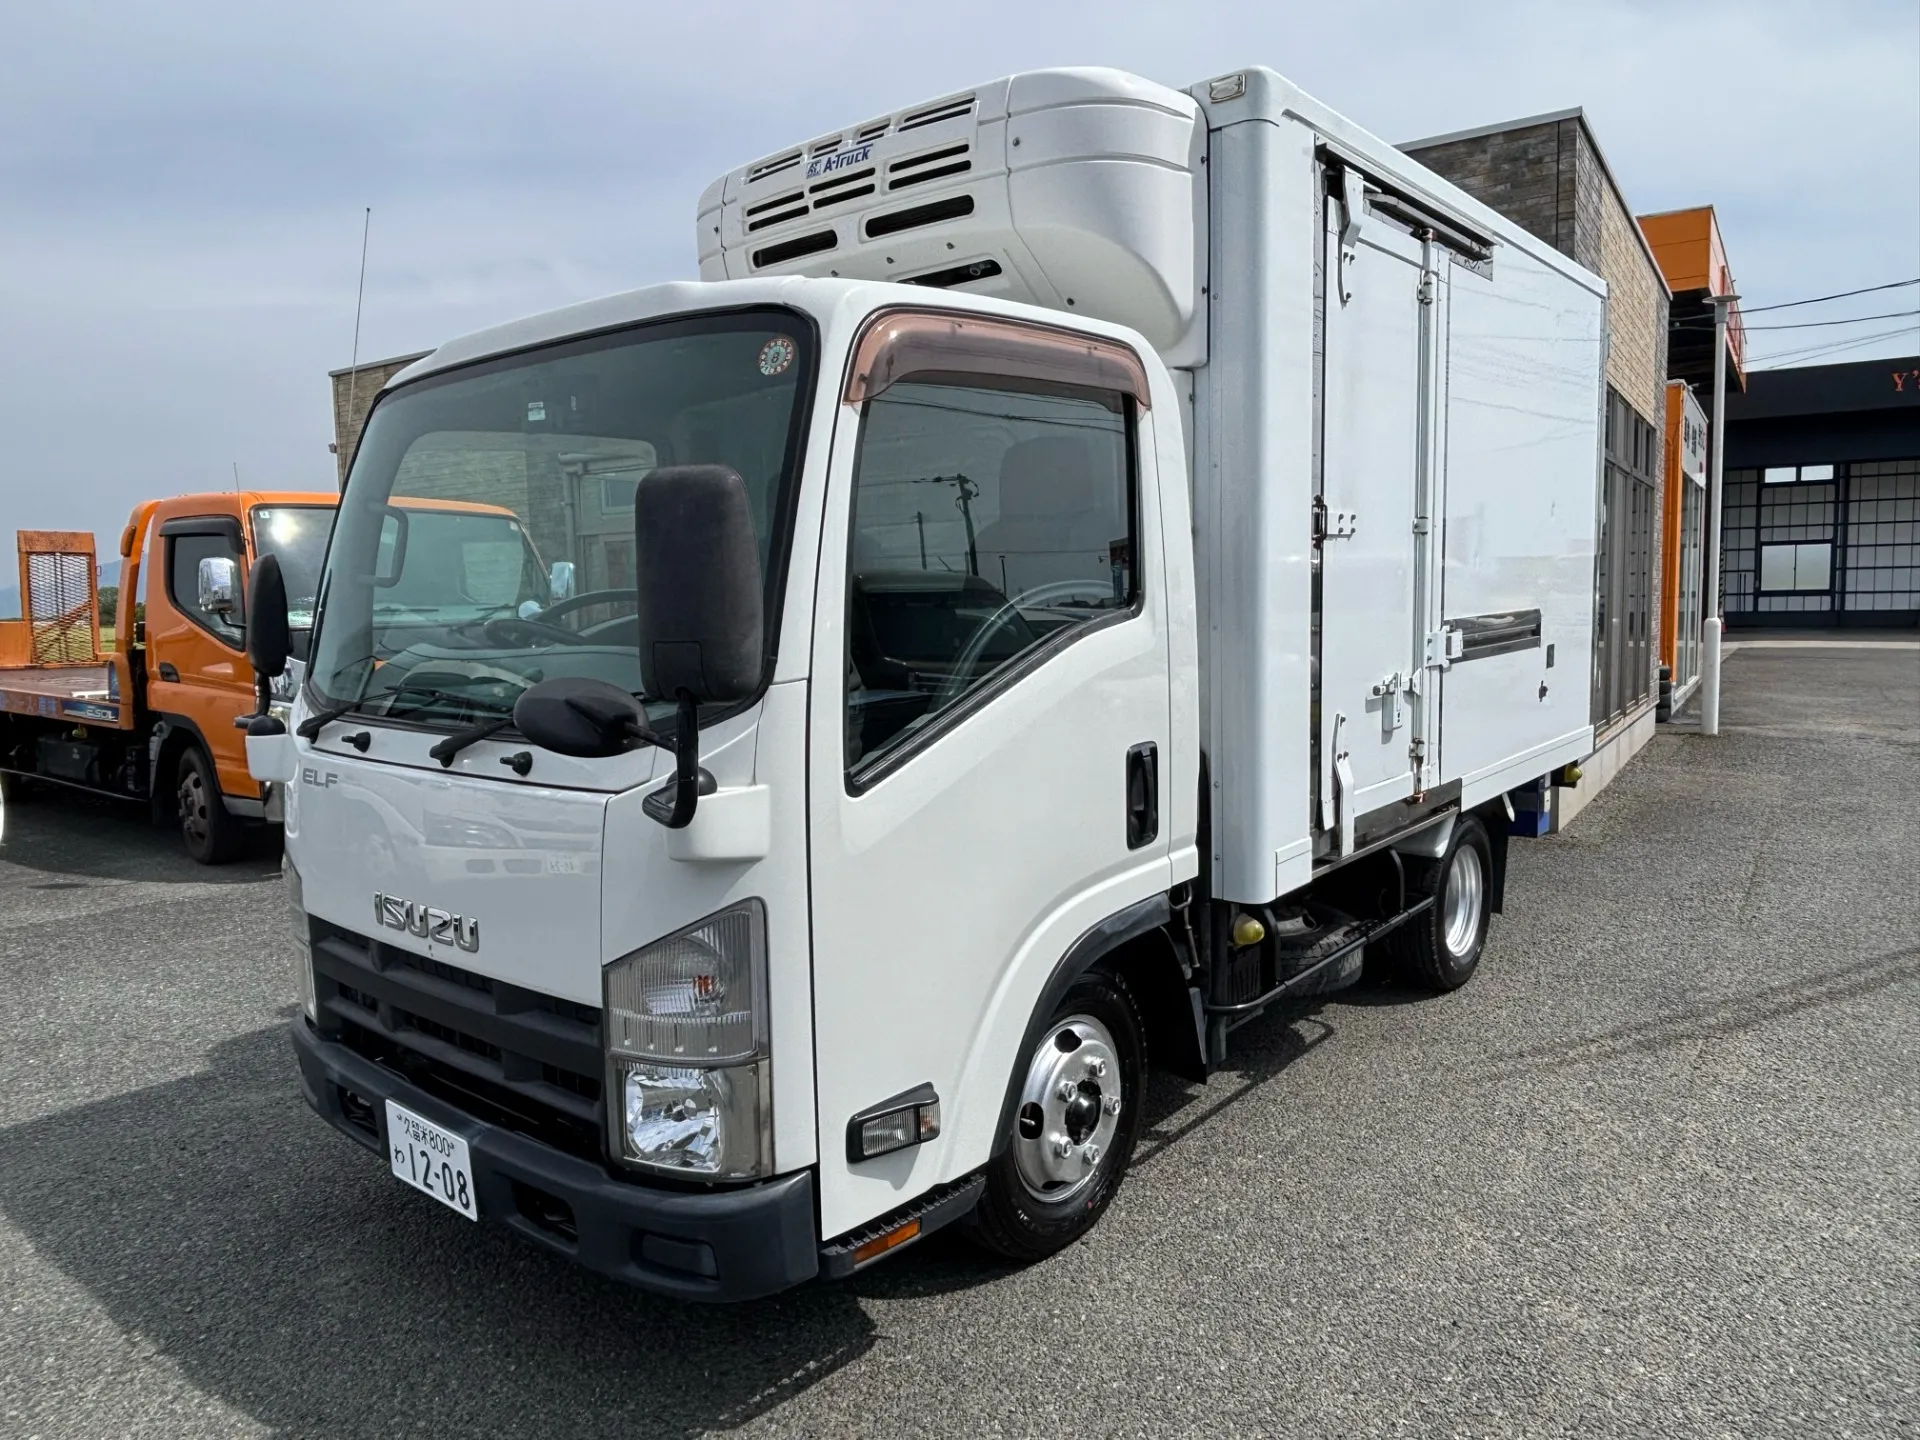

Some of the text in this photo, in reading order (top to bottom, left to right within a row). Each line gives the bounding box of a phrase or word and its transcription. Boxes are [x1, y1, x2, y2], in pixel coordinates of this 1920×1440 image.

[303, 768, 338, 788] ELF
[374, 891, 479, 953] ISUZU
[409, 1142, 470, 1210] 12-08
